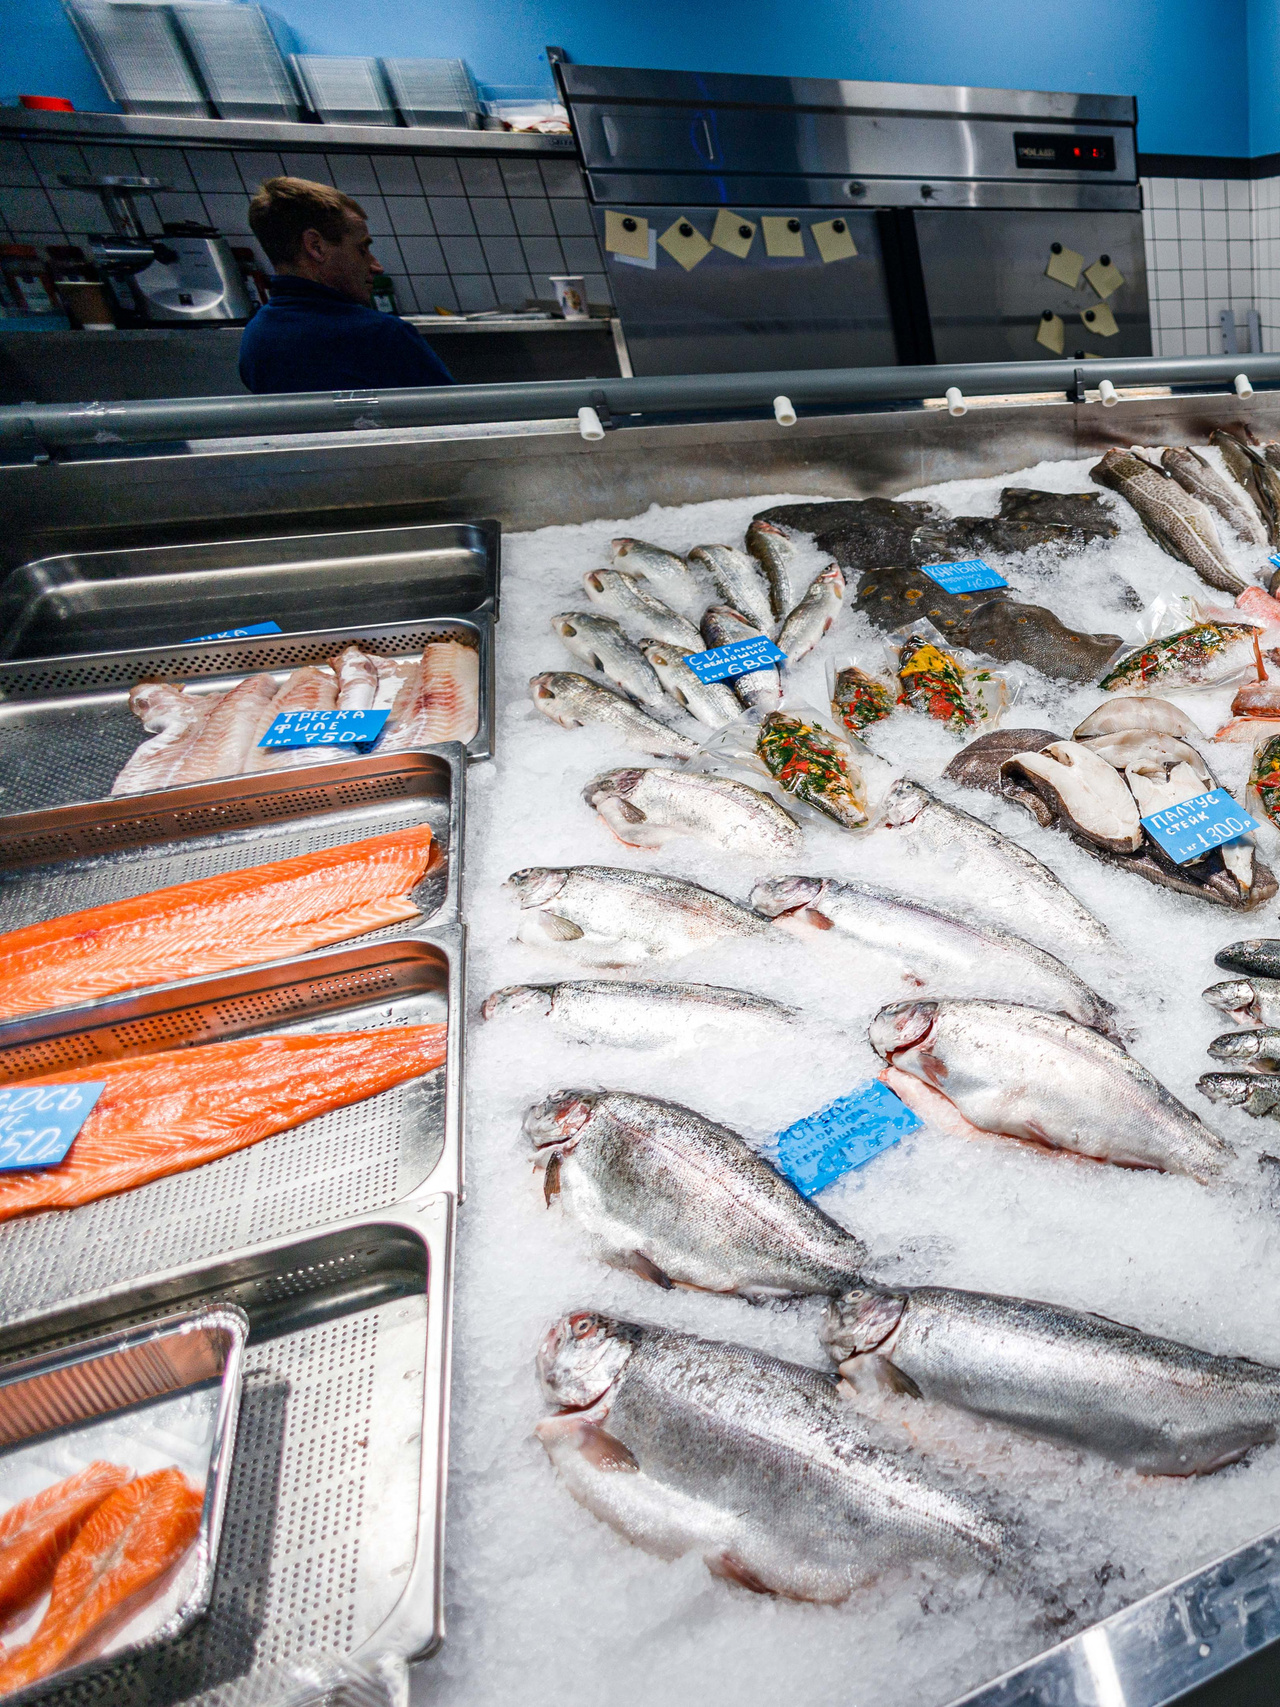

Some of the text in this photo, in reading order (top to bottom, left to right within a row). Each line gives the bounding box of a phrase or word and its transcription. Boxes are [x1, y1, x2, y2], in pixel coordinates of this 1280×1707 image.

[926, 560, 991, 578] КАМБАЛА
[689, 646, 731, 666] СИГ
[696, 646, 767, 671] СВЕЖАЙШИЙ
[284, 710, 365, 723] ТРЕСКА
[274, 721, 339, 734] ФИЛЕ
[1150, 794, 1220, 829] ПАЛТУС
[1165, 811, 1210, 836] СТЕЙК
